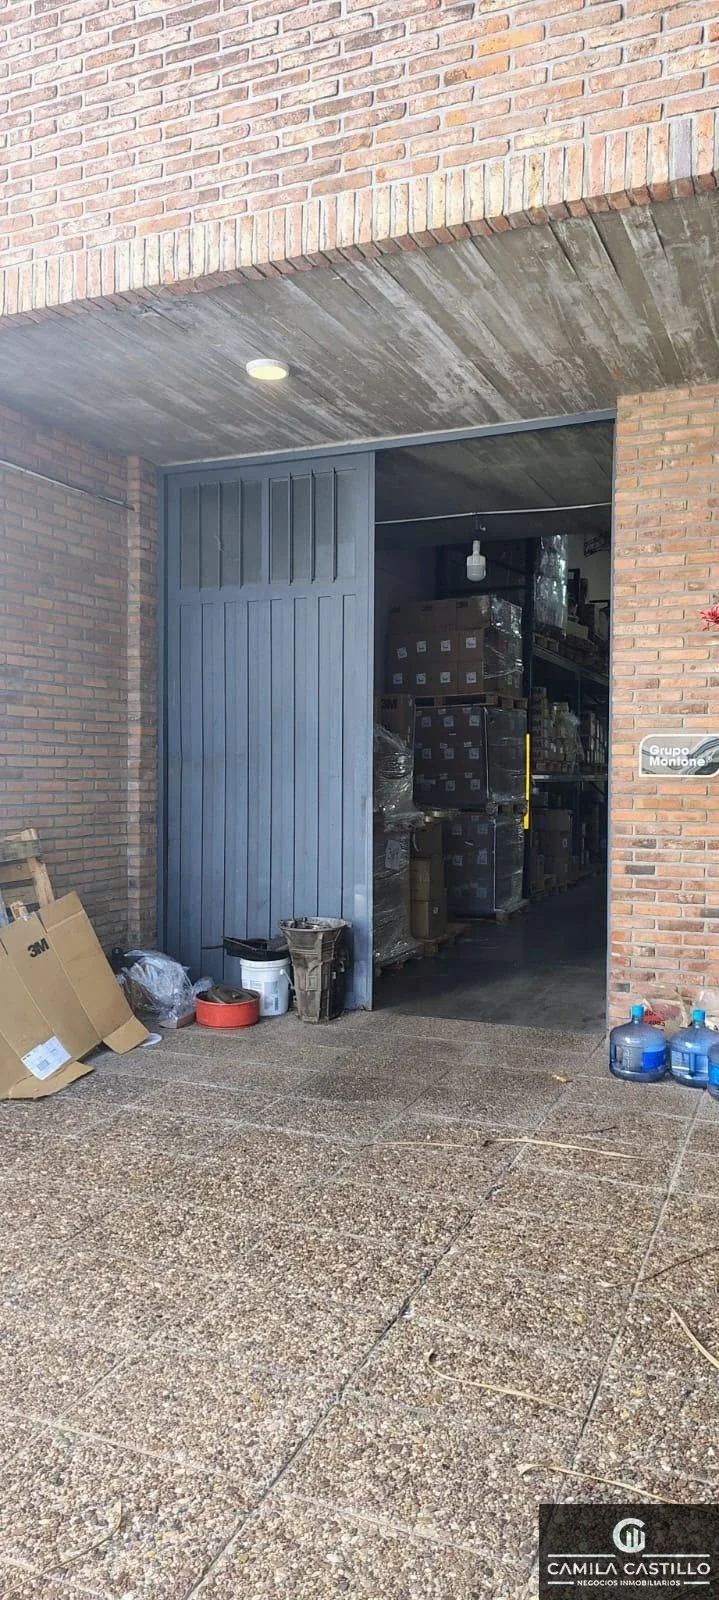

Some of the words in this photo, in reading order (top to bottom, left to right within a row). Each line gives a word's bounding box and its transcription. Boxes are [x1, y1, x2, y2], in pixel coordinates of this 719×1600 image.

[649, 745, 690, 757] Grupo
[649, 756, 706, 767] Montone
[27, 938, 50, 958] 3M
